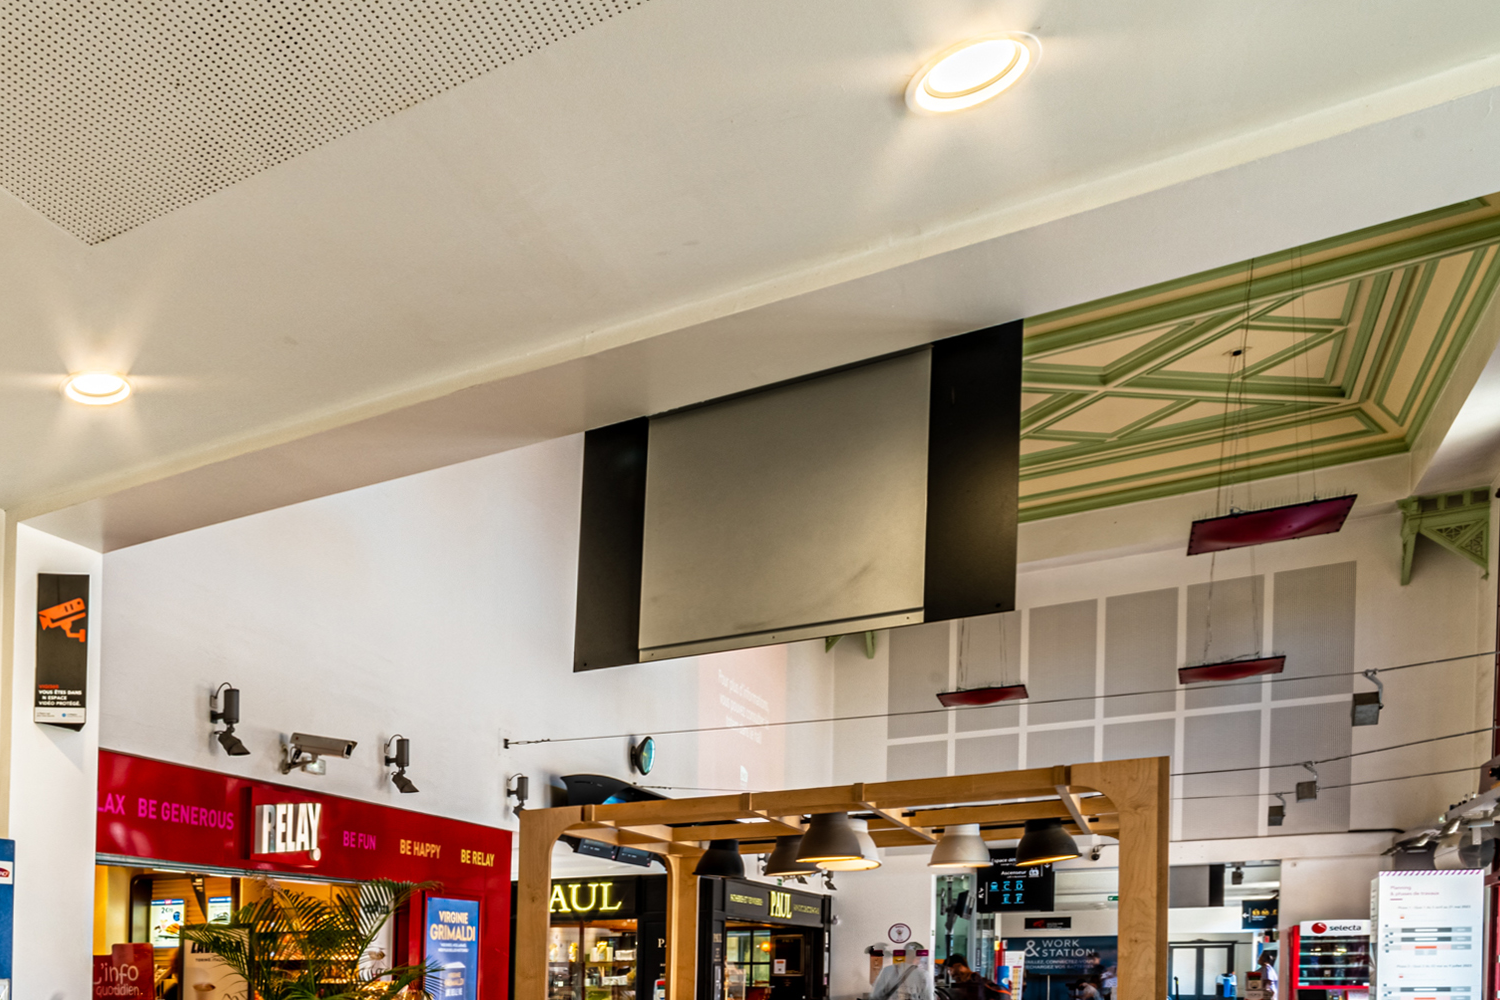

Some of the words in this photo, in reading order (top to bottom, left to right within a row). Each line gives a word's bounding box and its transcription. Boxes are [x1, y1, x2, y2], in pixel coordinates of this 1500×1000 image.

[98, 793, 126, 815] LAX
[138, 798, 157, 820] BE
[161, 802, 234, 830] GENEROUS
[256, 803, 322, 853] RELAY
[343, 830, 356, 848] BE
[358, 833, 376, 850] FUN
[400, 839, 412, 855] BE
[413, 842, 441, 859] HAPPY
[460, 849, 471, 864] BE
[472, 851, 495, 867] RELAY
[550, 882, 622, 912] AUL
[770, 890, 792, 919] PAUL
[439, 911, 469, 924] VIRGINIE
[430, 924, 476, 941] GRIMALDI
[1024, 940, 1041, 957] &
[1042, 939, 1079, 947] WORK
[1042, 948, 1095, 957] STATION
[96, 984, 143, 997] quotidien.
